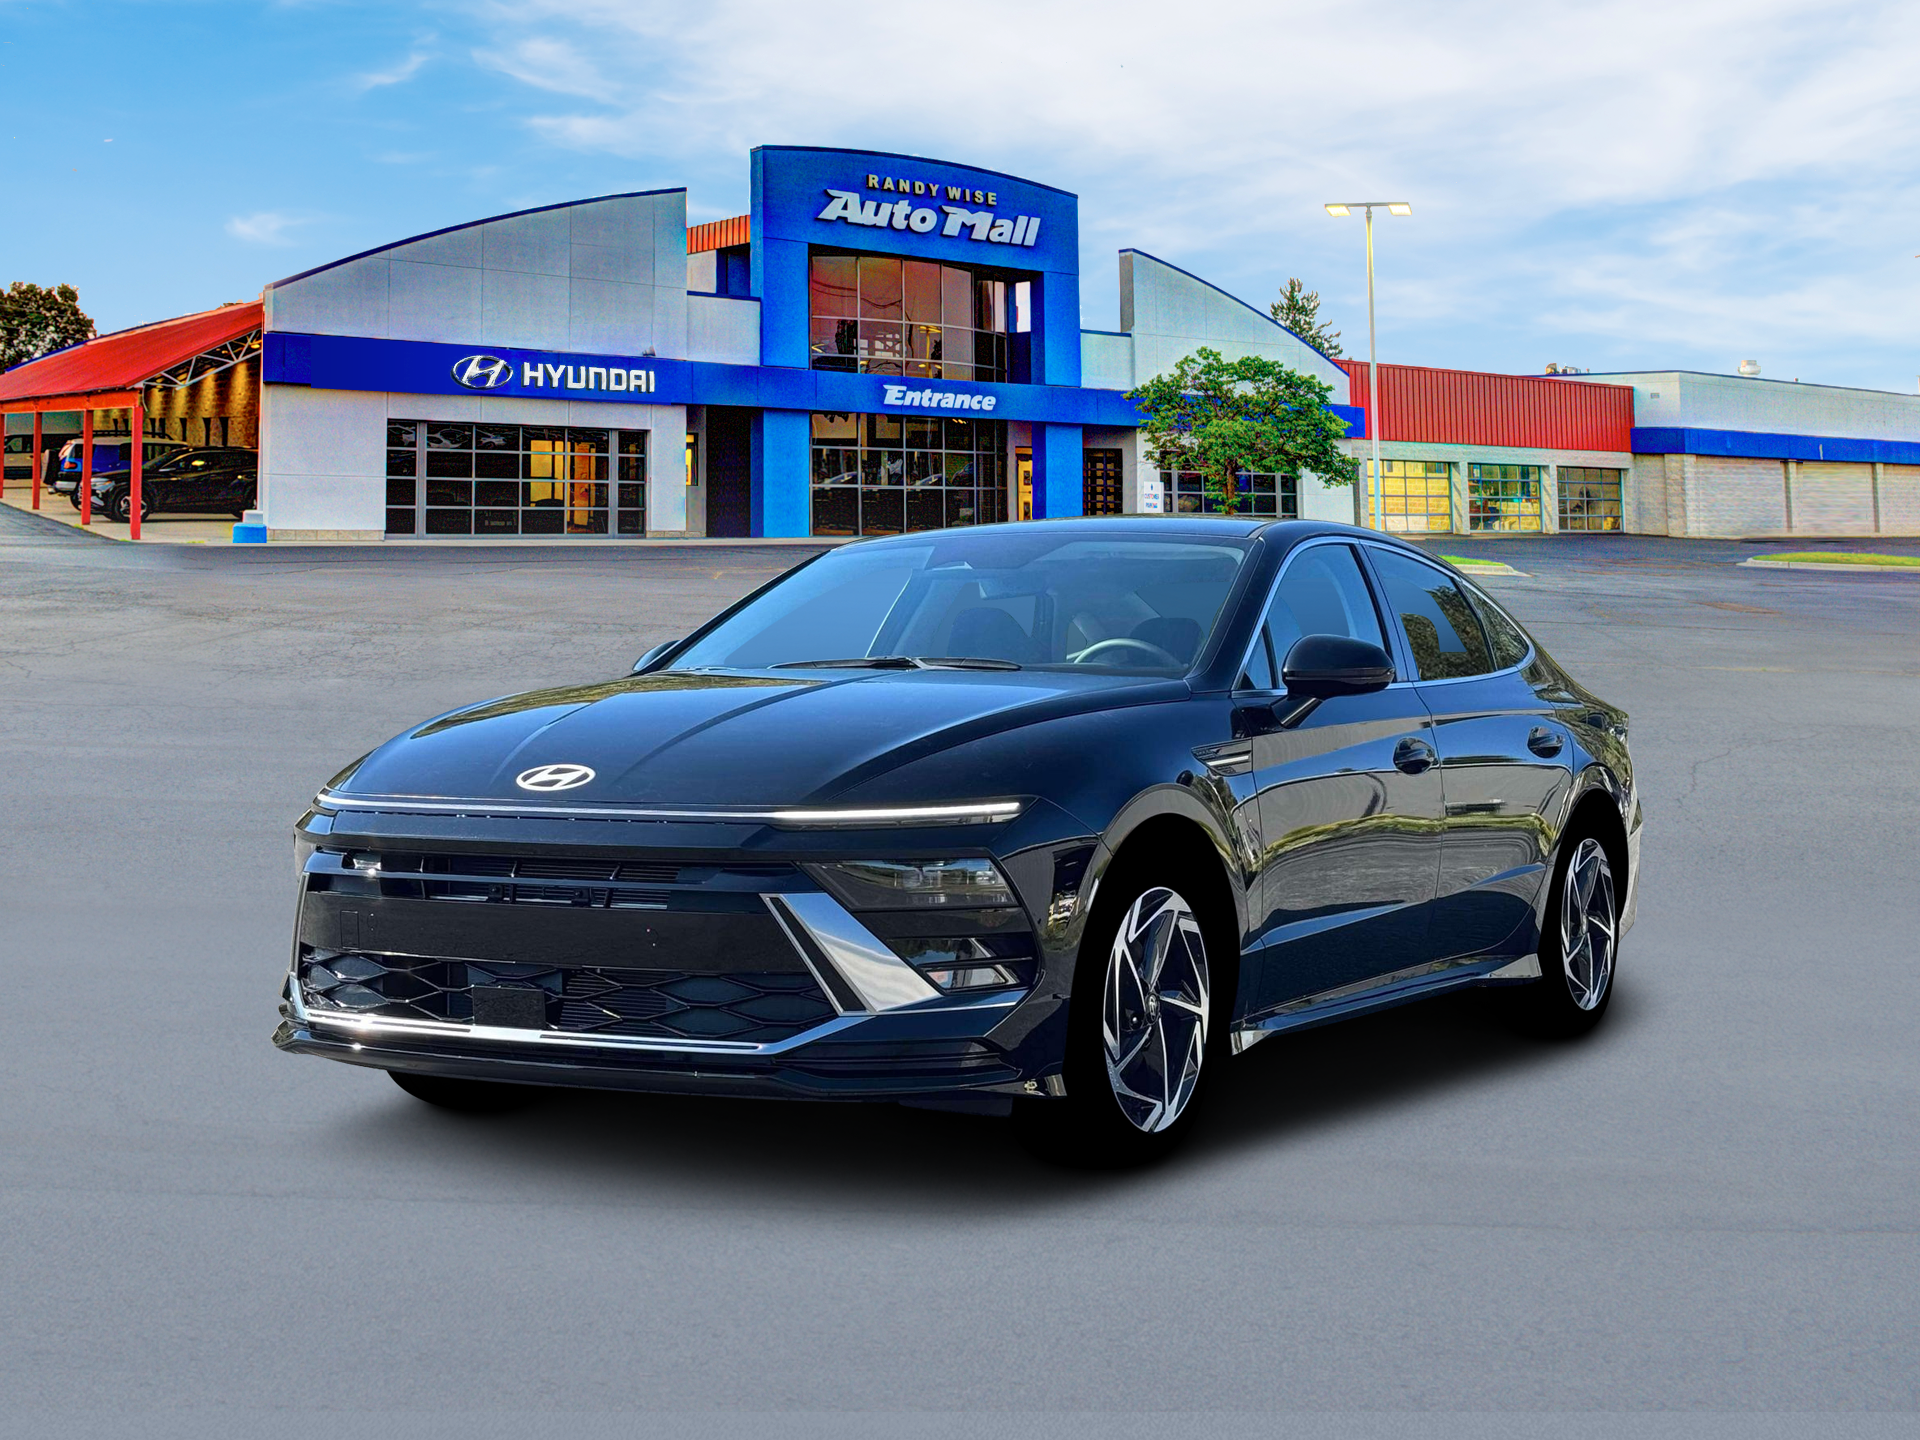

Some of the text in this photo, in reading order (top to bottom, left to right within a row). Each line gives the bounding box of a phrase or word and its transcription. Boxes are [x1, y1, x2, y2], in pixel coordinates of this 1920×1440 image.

[867, 174, 997, 205] RANDY WISE
[819, 189, 1041, 246] Auto Mall
[522, 362, 655, 392] HYUNDAI
[883, 384, 996, 411] Entrance
